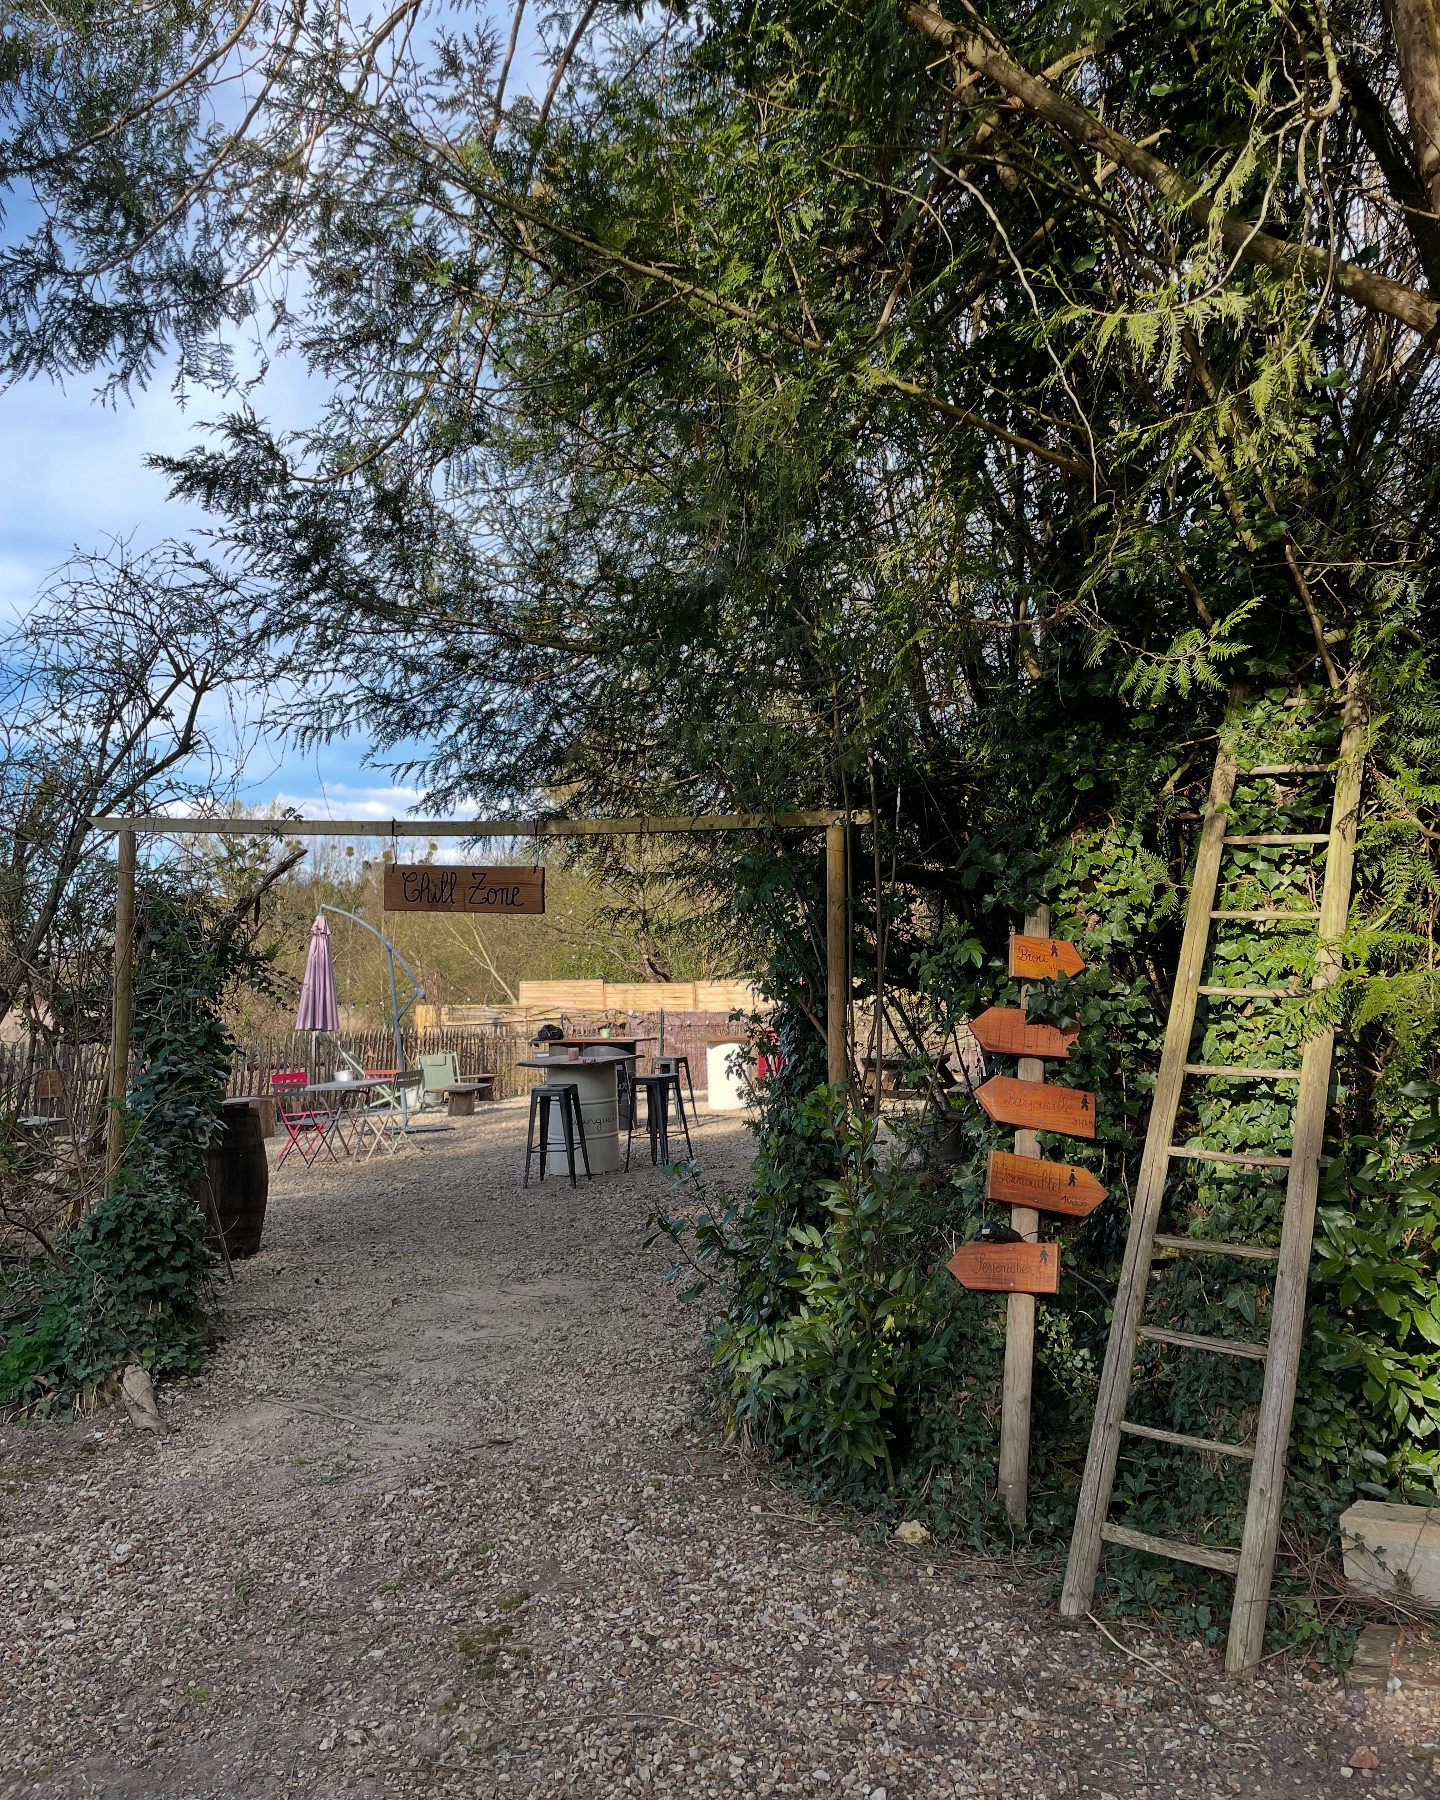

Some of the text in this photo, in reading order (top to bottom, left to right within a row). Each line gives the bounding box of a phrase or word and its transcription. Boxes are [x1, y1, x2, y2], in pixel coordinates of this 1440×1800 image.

[401, 871, 525, 908] Chill Zone
[1016, 945, 1048, 963] Brou
